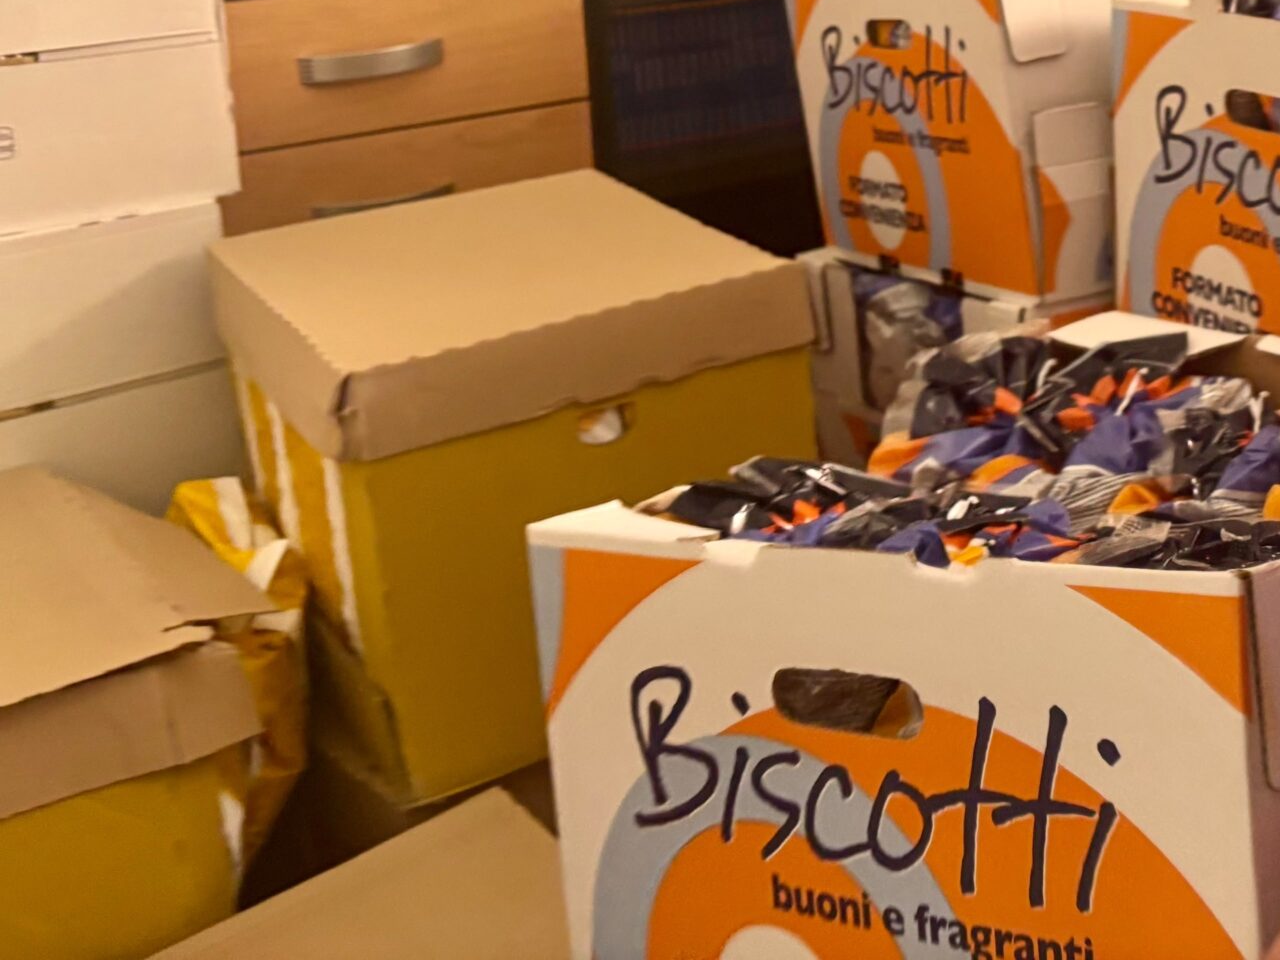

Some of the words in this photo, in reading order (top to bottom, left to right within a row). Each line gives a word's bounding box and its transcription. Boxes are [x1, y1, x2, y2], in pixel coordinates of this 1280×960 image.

[821, 25, 967, 124] Biscotti
[1172, 267, 1263, 318] FORMATO
[630, 665, 1121, 913] Biscotti
[772, 874, 872, 930] buoni
[882, 905, 905, 936] e
[914, 903, 1094, 960] fragranti
